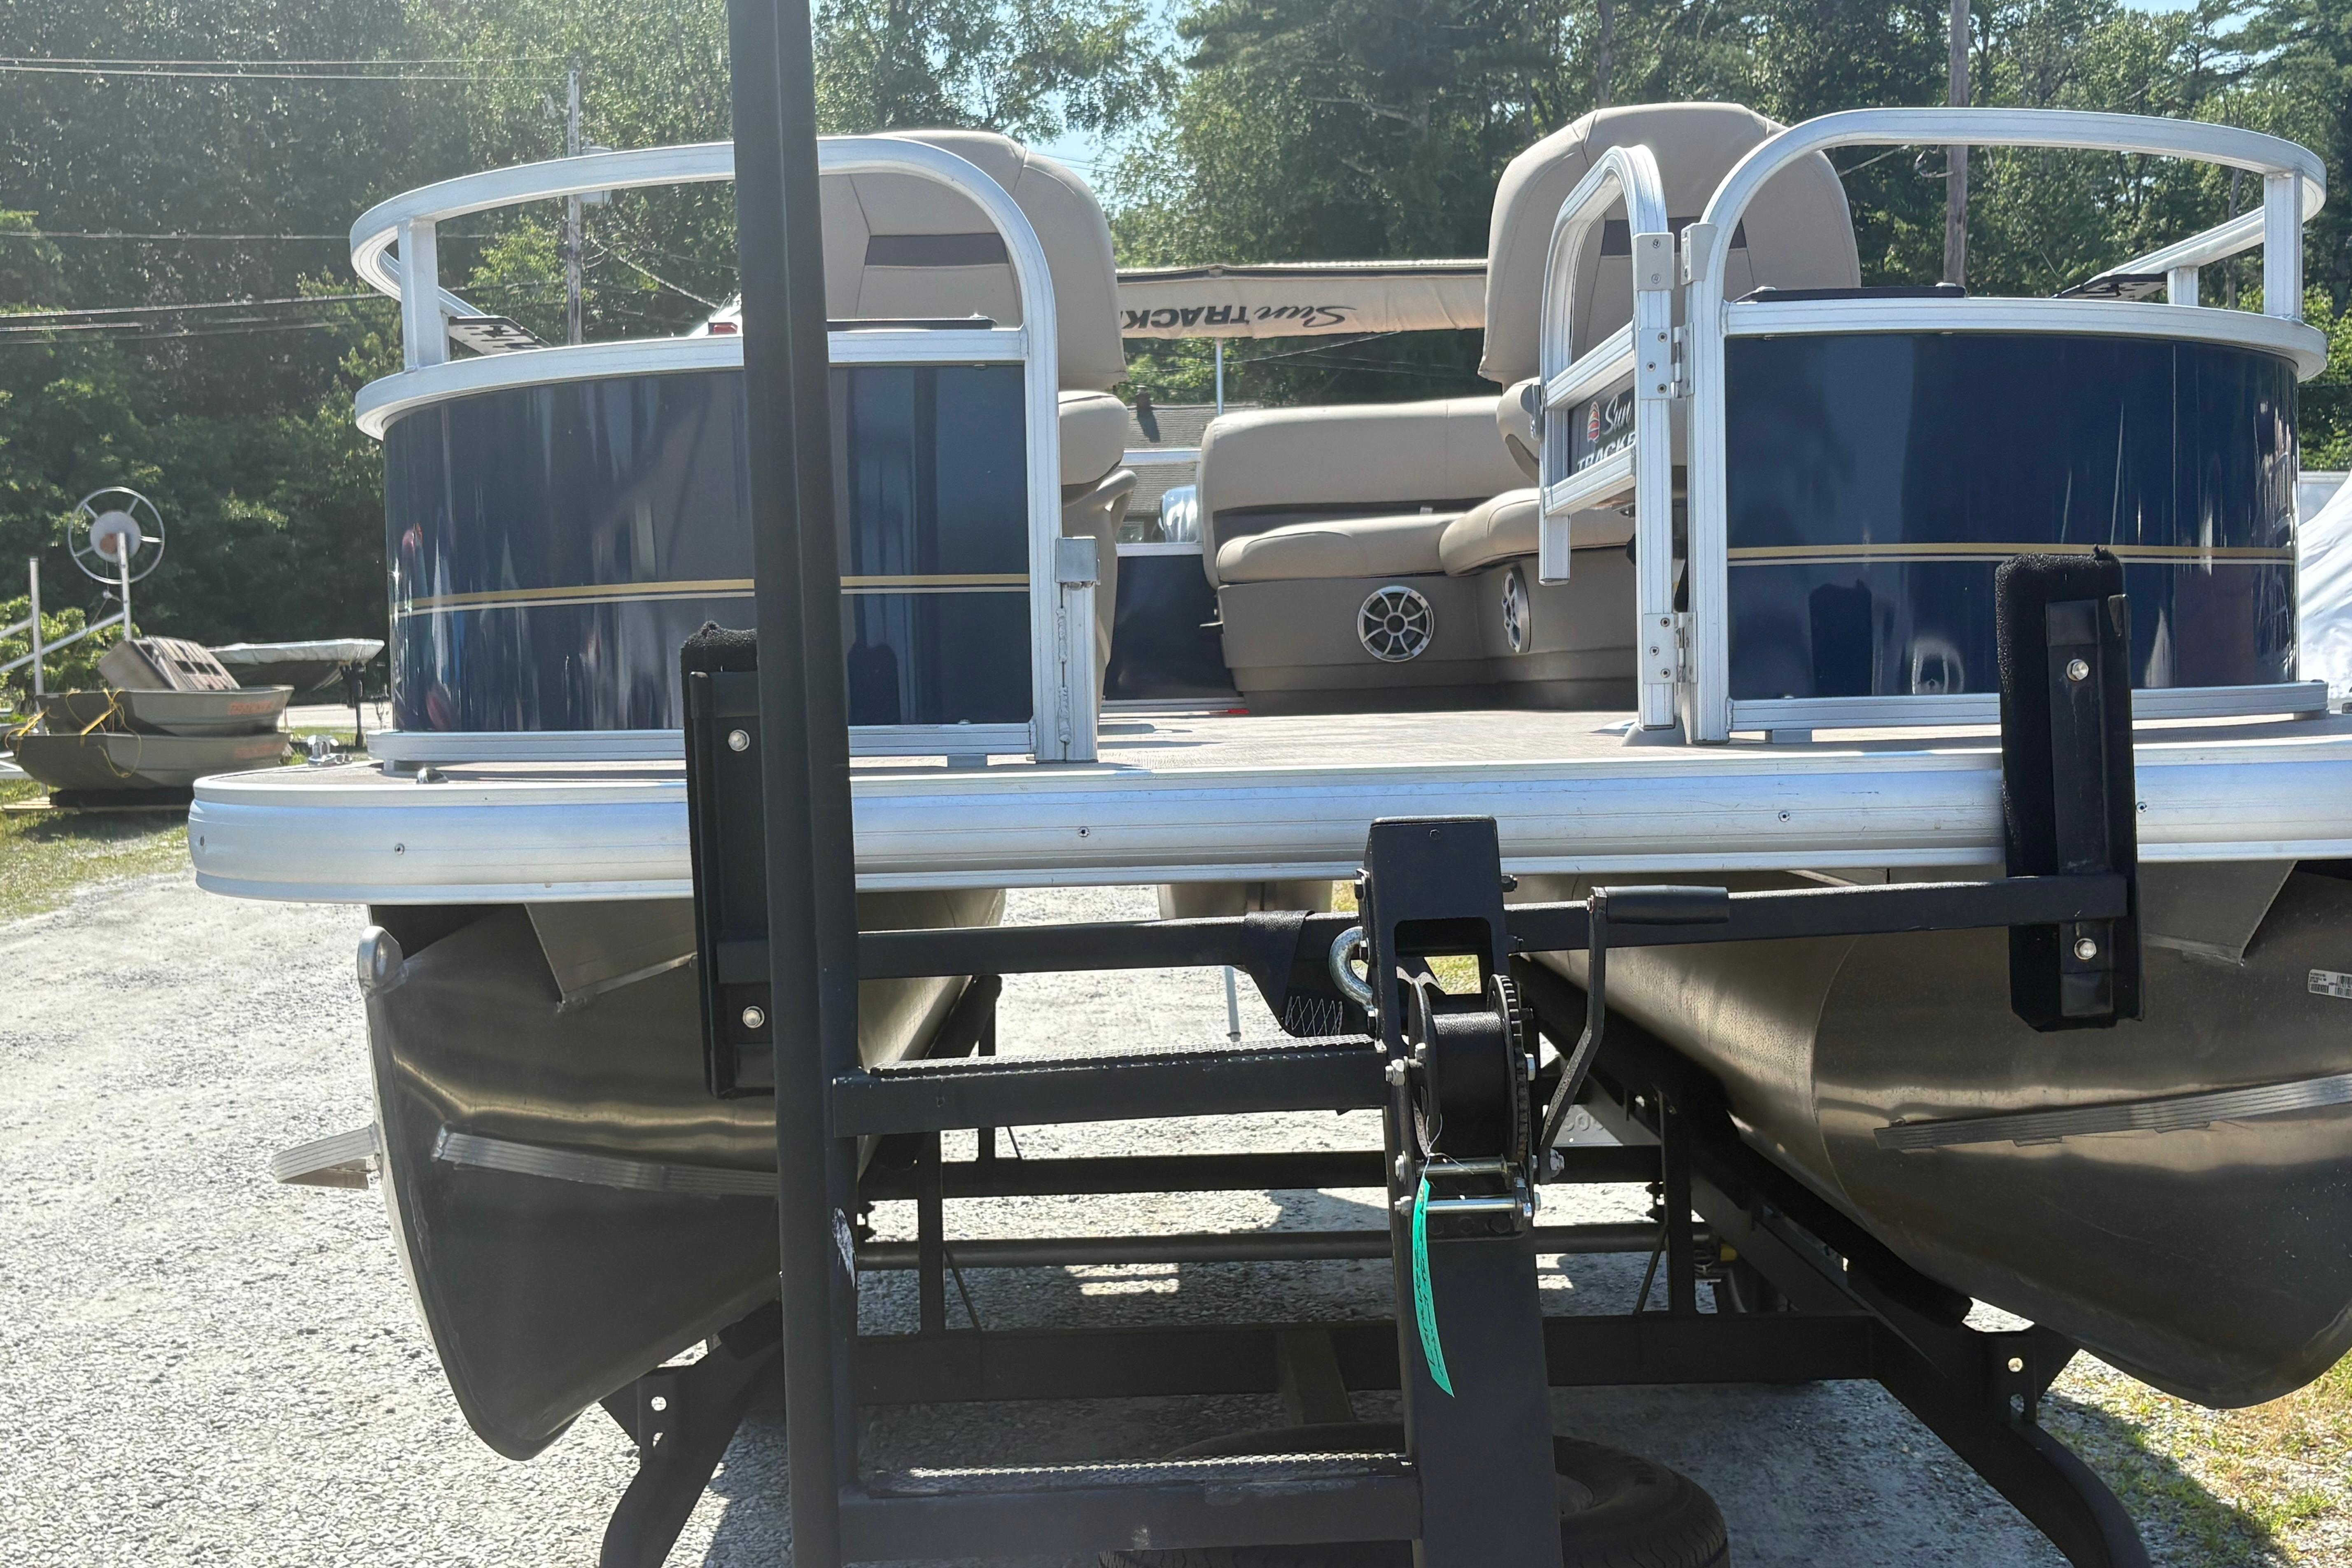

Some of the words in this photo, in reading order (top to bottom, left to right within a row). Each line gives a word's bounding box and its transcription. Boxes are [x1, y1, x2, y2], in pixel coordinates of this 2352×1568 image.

[1120, 305, 1250, 329] TRACK
[1253, 305, 1358, 327] Sun
[1601, 393, 1633, 434] Sun
